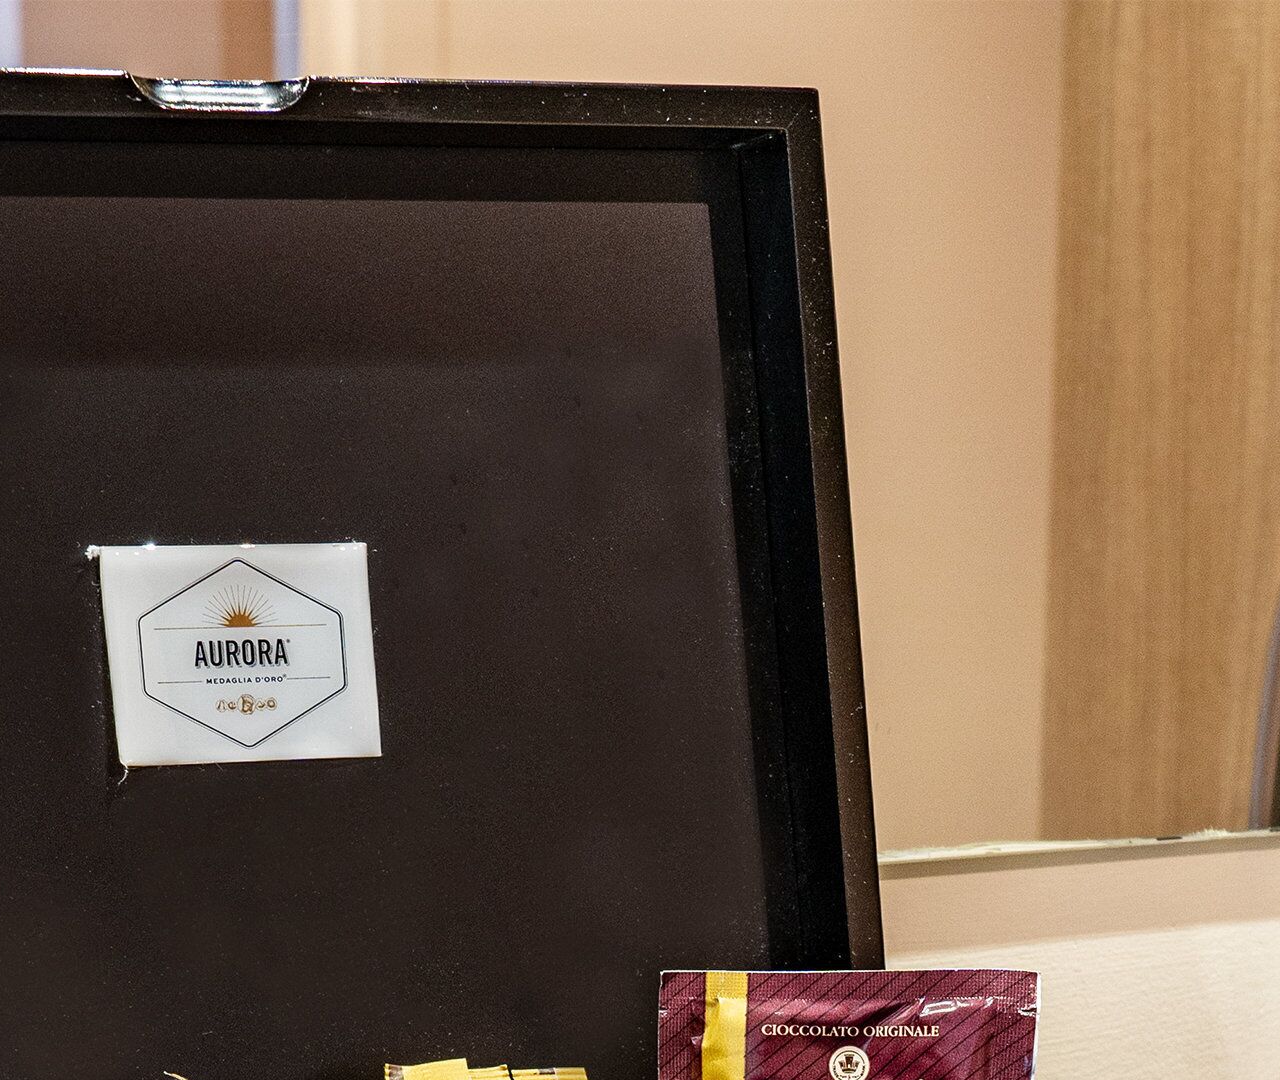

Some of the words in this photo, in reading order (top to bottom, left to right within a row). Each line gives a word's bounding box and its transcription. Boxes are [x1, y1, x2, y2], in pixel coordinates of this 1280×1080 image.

[195, 638, 289, 669] AURORA
[206, 676, 252, 684] MEDAGLIA
[255, 674, 284, 683] D'ORO
[760, 1024, 859, 1037] CIOCCOLATO
[863, 1025, 940, 1037] ORIGINALE
